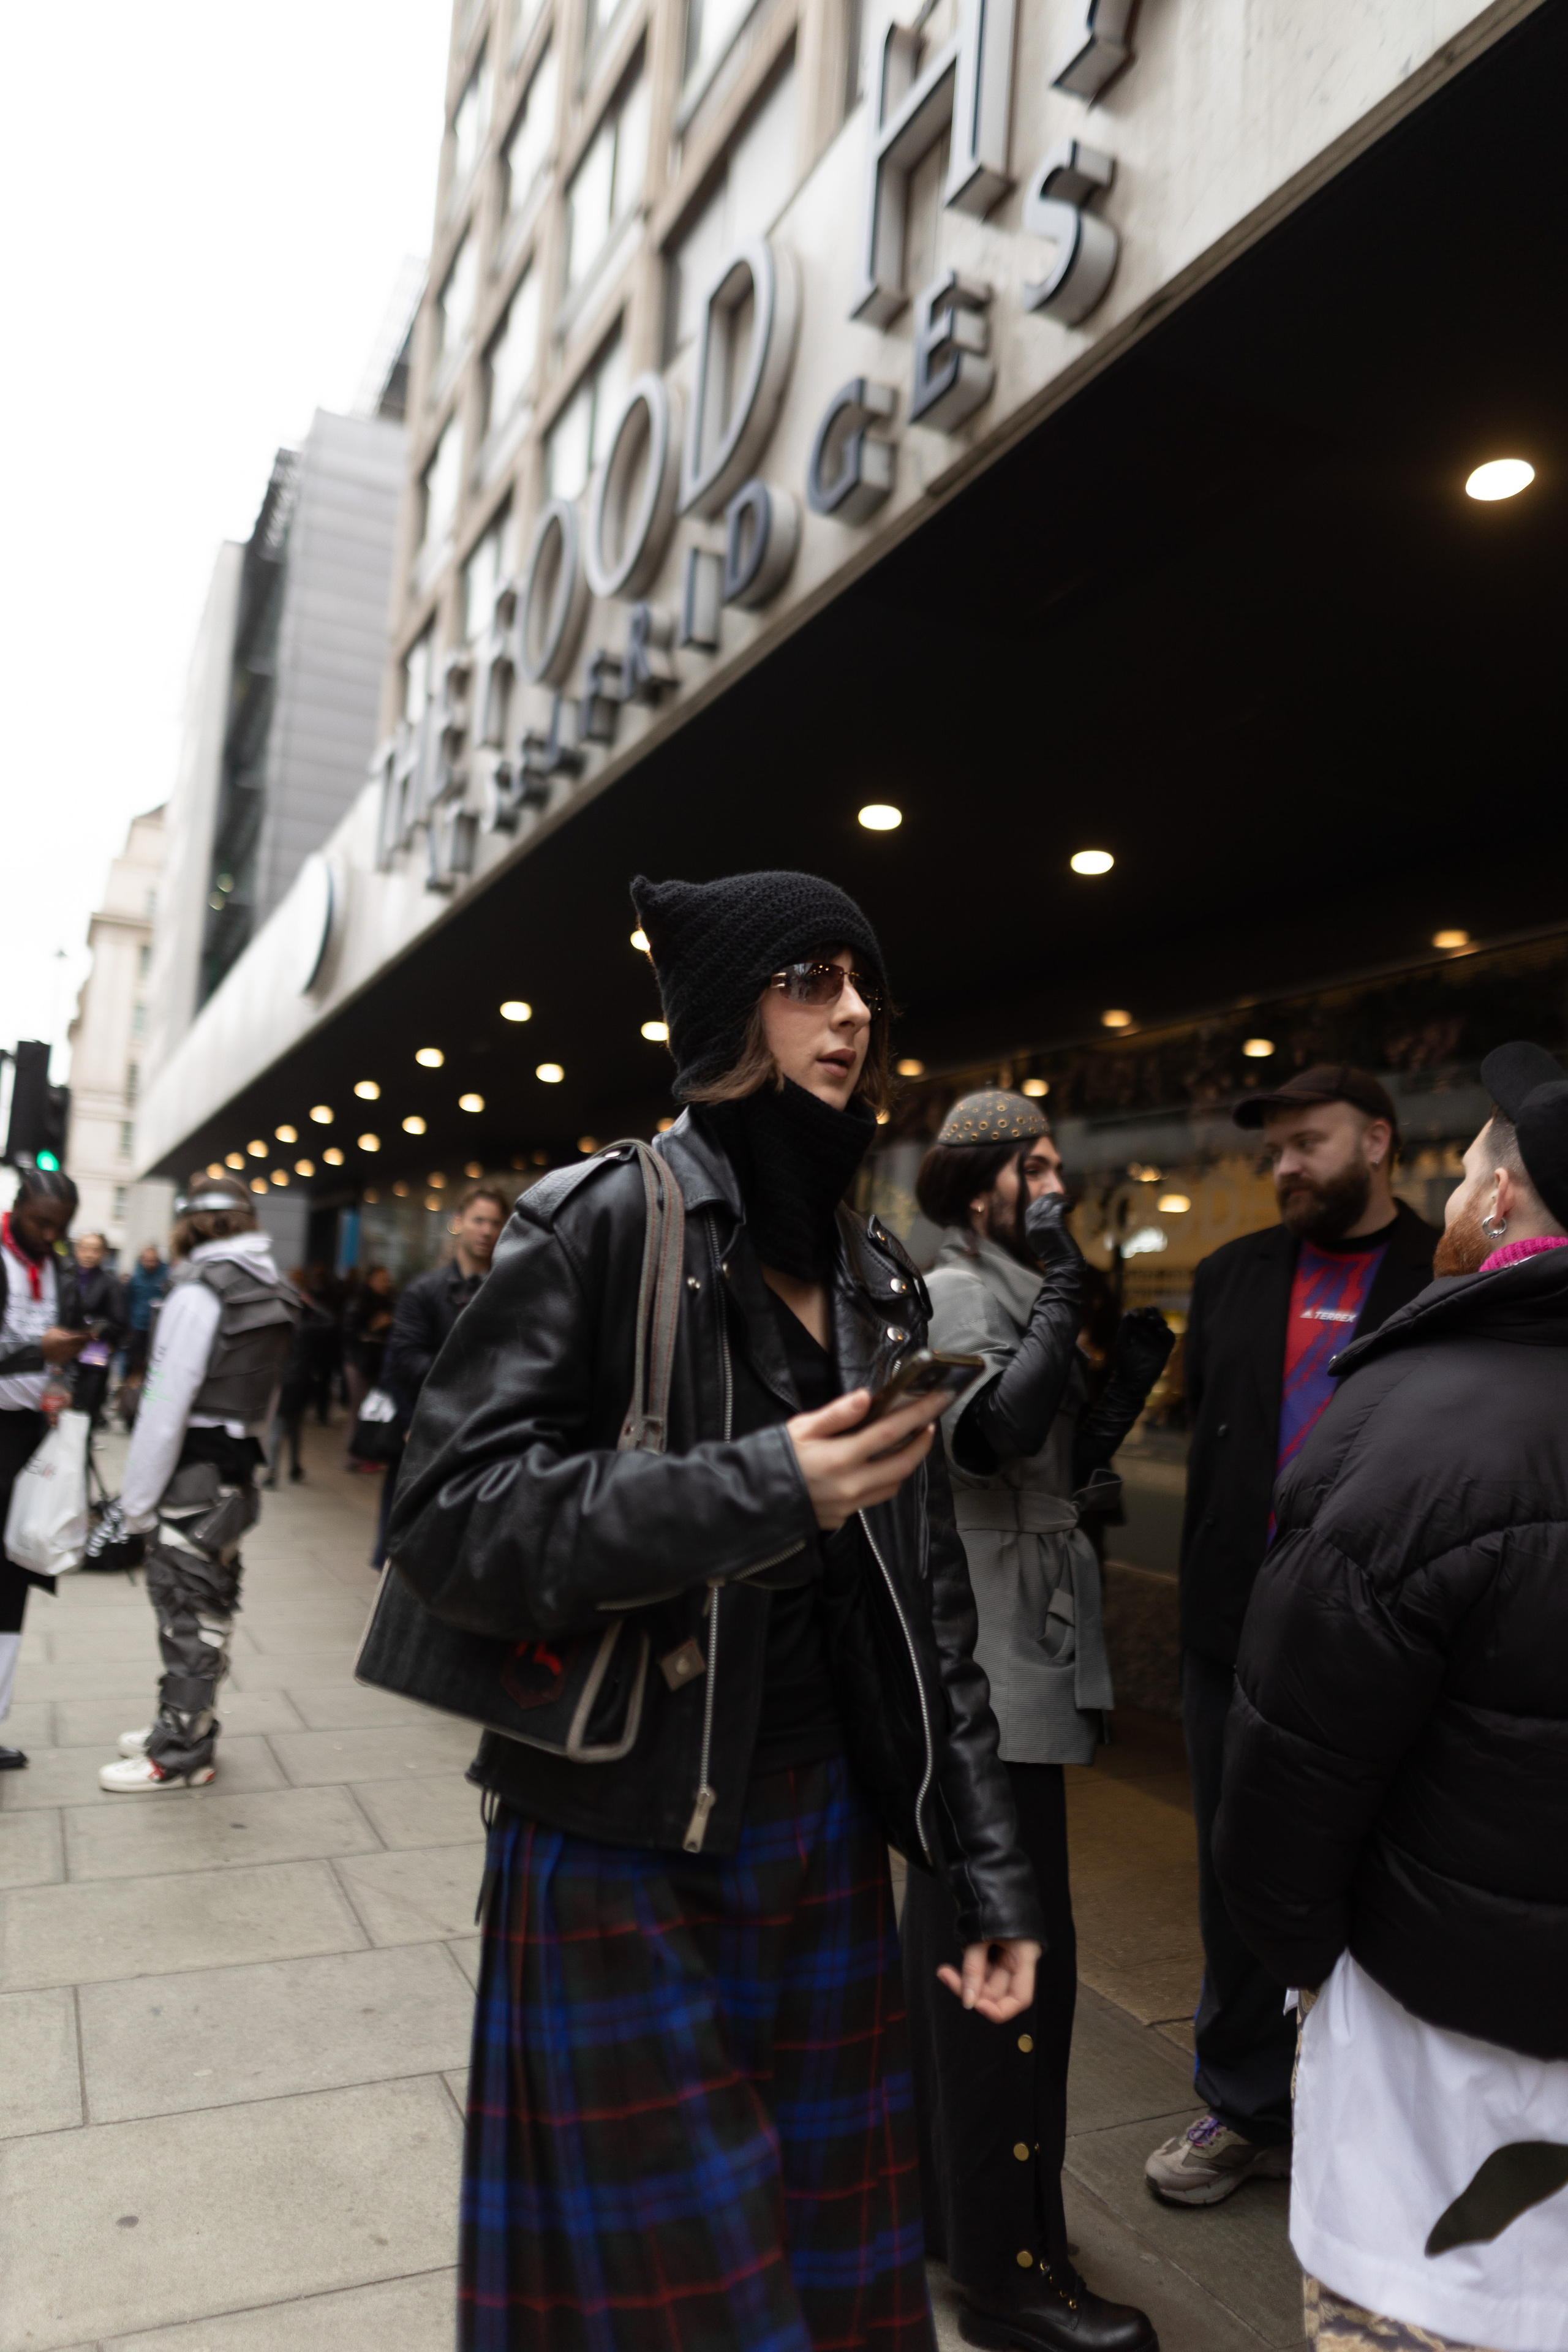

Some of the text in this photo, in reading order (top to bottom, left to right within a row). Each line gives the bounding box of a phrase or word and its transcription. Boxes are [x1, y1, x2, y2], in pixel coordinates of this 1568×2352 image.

[480, 138, 1093, 834] SELFRIDGES
[369, 650, 462, 872] THE
[1314, 1312, 1356, 1322] TERREX
